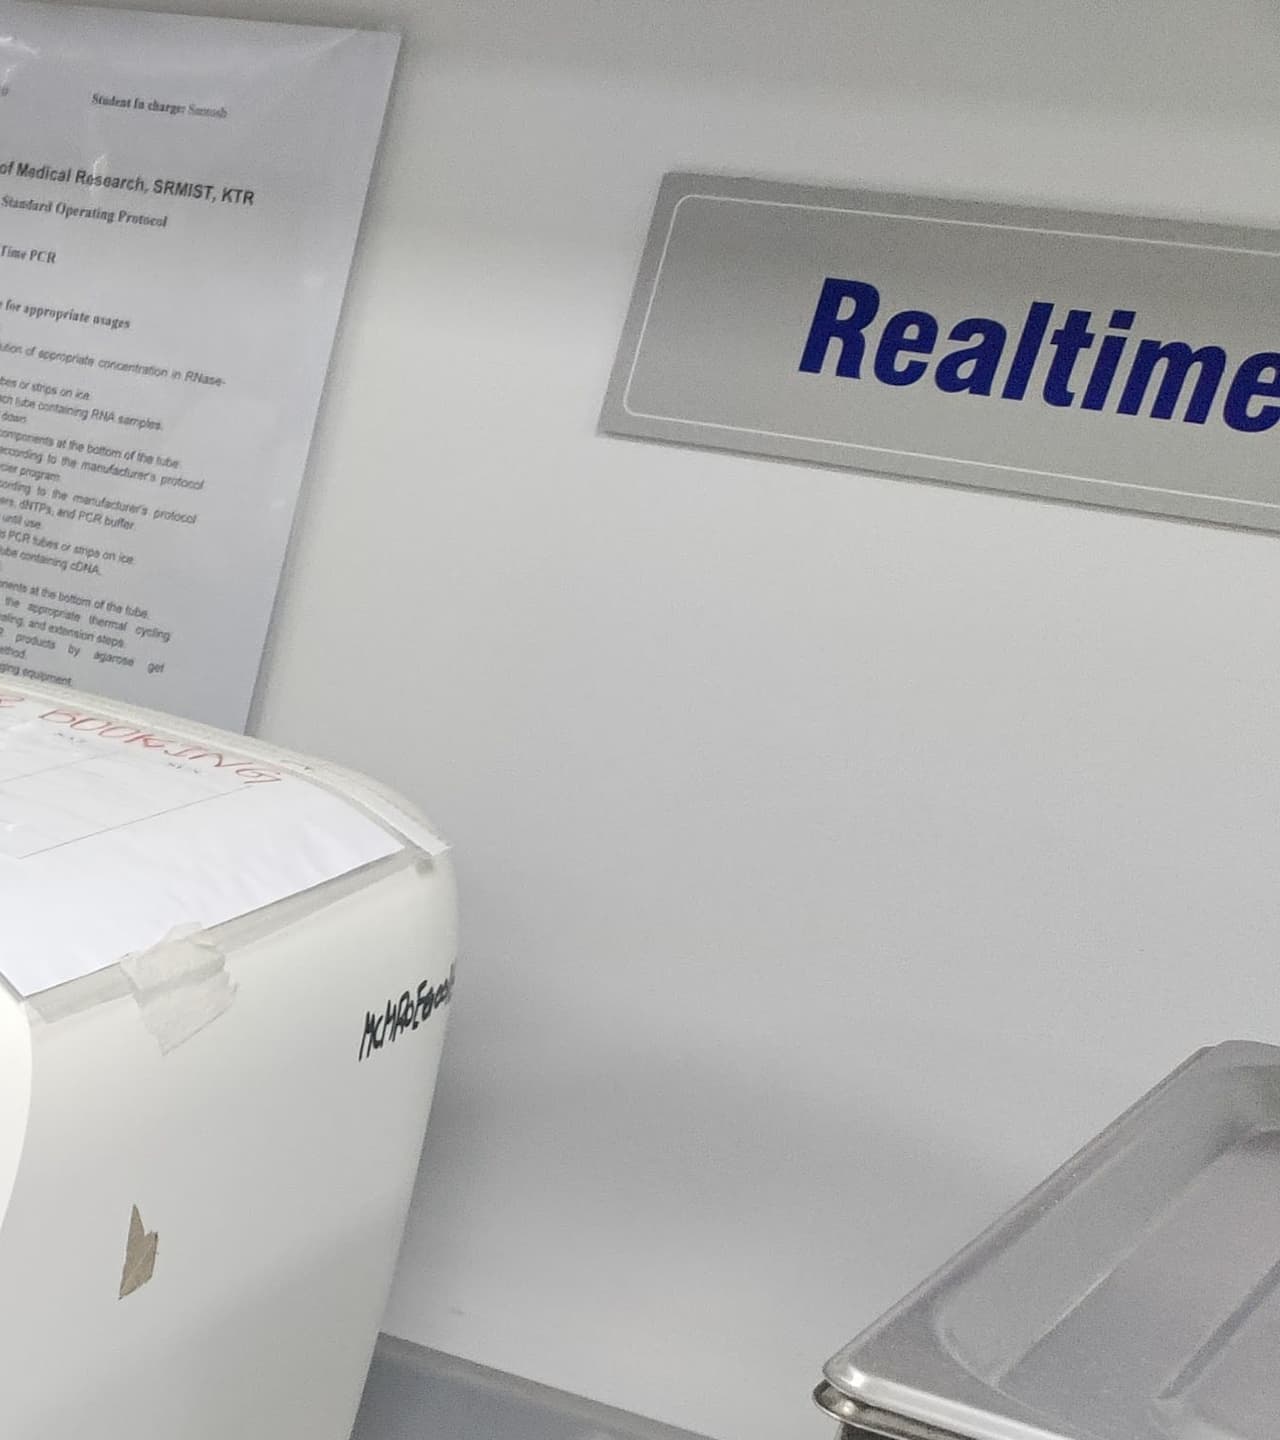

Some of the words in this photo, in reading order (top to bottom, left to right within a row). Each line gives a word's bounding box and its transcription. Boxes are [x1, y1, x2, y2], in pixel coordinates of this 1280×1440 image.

[91, 93, 131, 108] Student
[132, 97, 145, 109] In
[16, 162, 71, 181] Medical
[152, 179, 215, 201] SRMIST,
[221, 187, 254, 205] KTR
[1, 195, 52, 212] Standard
[55, 202, 115, 223] Operating
[117, 209, 168, 227] Protocol
[0, 244, 26, 259] Time
[28, 249, 56, 263] PCR
[4, 298, 21, 312] for
[23, 305, 90, 322] appropriate
[92, 315, 130, 329] usages
[38, 350, 94, 366] appropriate
[97, 359, 167, 376] concentration
[171, 369, 181, 380] in
[798, 277, 1280, 433] Realtime
[38, 401, 88, 419] containing
[90, 408, 115, 422] RNA
[56, 439, 66, 448] at
[68, 439, 84, 452] the
[86, 443, 121, 458] bottom
[123, 450, 135, 460] of
[136, 451, 153, 464] the
[60, 455, 76, 468] the
[36, 485, 46, 496] to
[51, 488, 67, 501] the
[4, 595, 20, 608] the
[27, 603, 80, 621] appropriate
[88, 614, 127, 631] thermal
[135, 626, 170, 643] cycling
